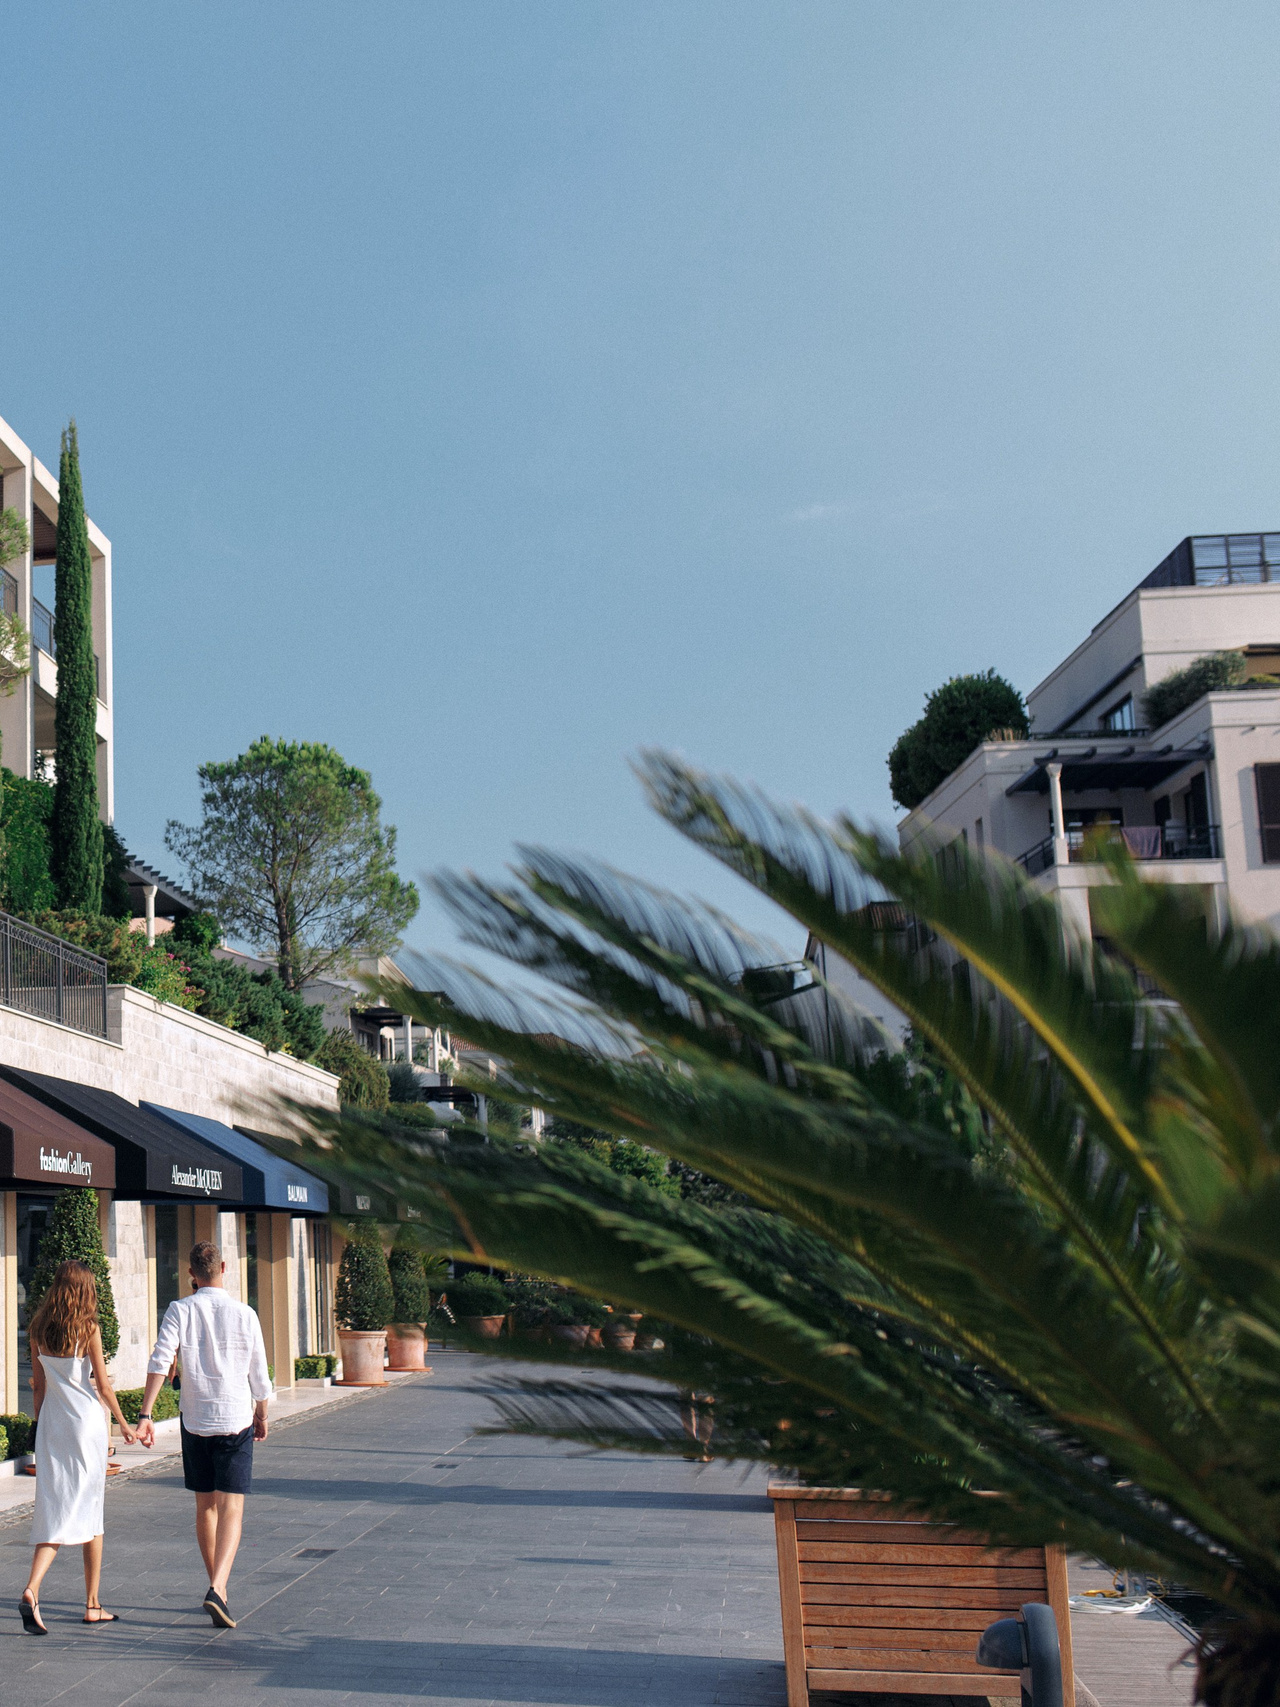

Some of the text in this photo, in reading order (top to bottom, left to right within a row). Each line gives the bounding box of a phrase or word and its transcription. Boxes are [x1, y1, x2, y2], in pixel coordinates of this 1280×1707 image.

[171, 1164, 223, 1196] Alexander McQUEEN
[287, 1184, 308, 1203] BALMAIN
